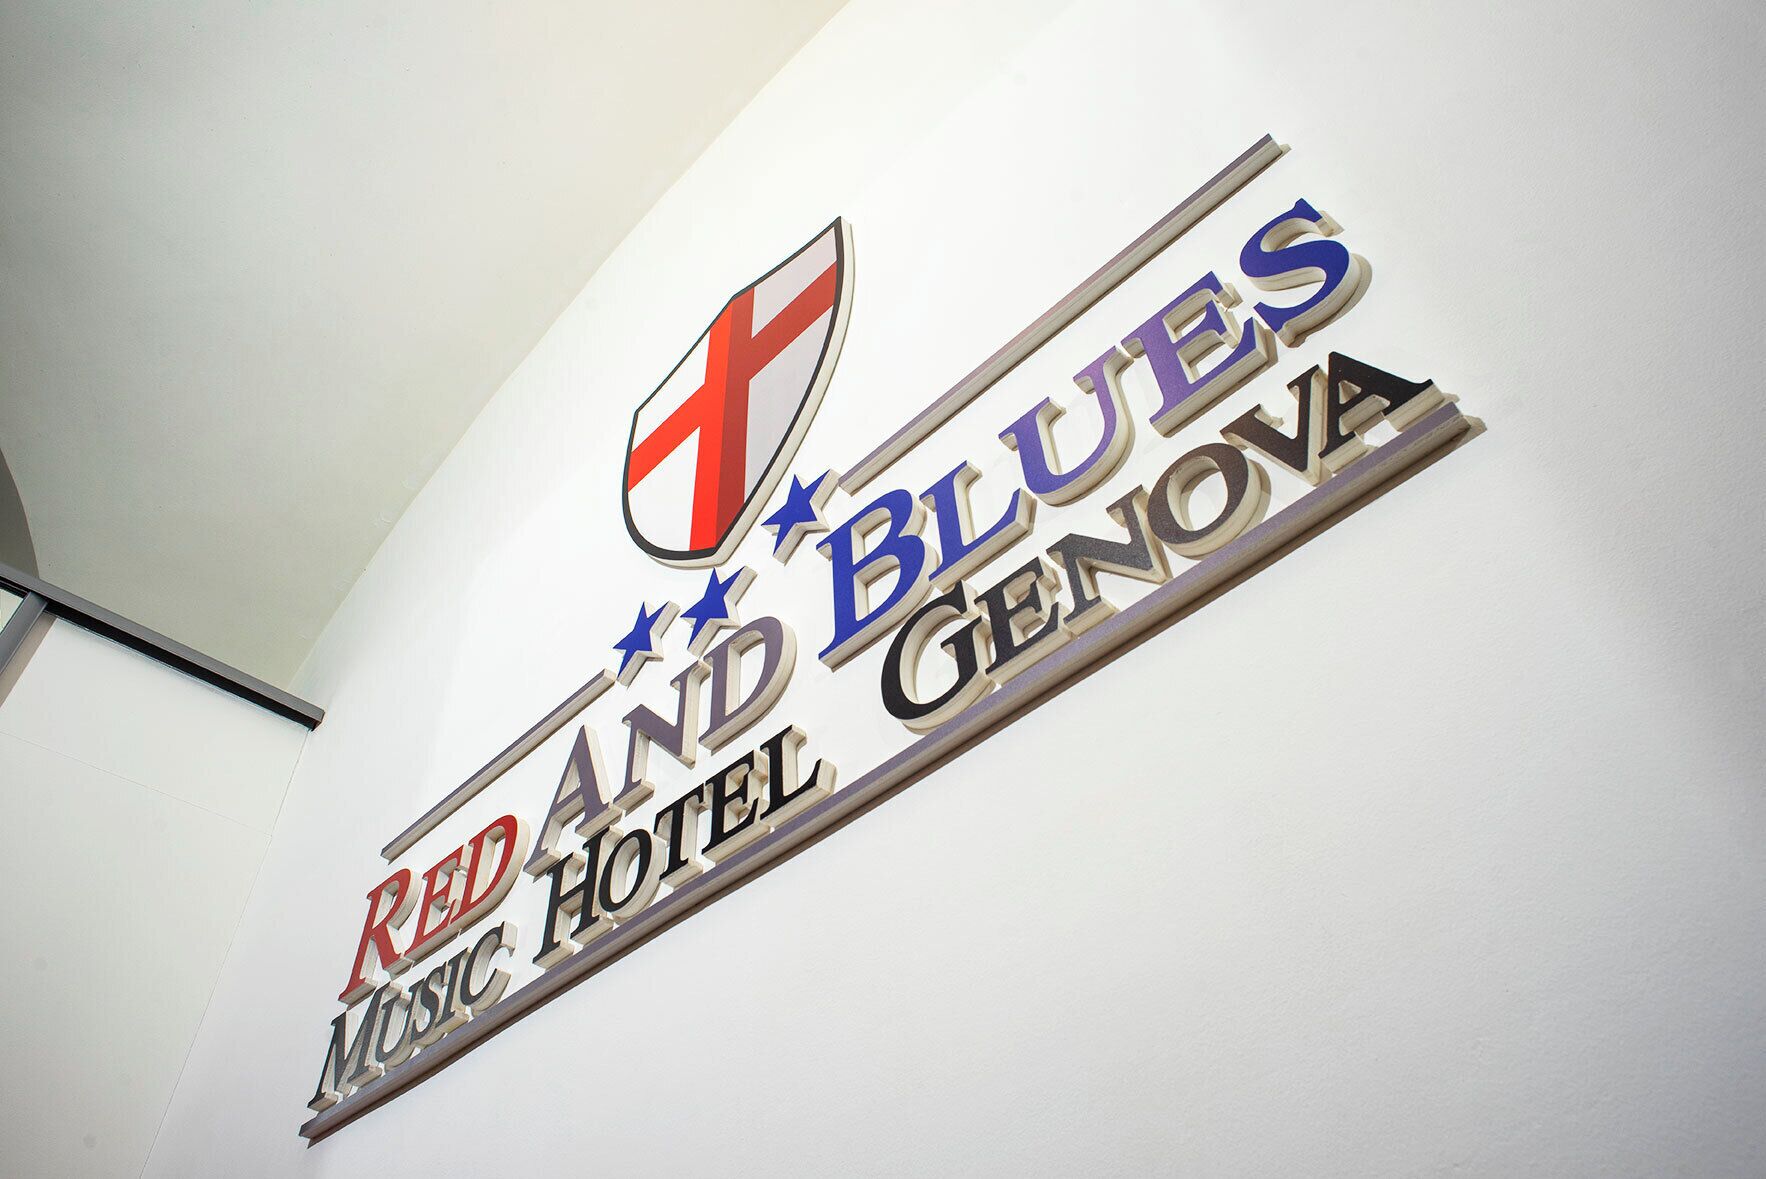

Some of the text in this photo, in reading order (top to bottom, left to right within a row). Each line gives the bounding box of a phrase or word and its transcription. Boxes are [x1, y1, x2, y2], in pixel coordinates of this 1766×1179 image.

[307, 351, 1437, 1108] MUSIC HOTEL GENOVA
[338, 198, 1354, 1002] RED AND BLUES
